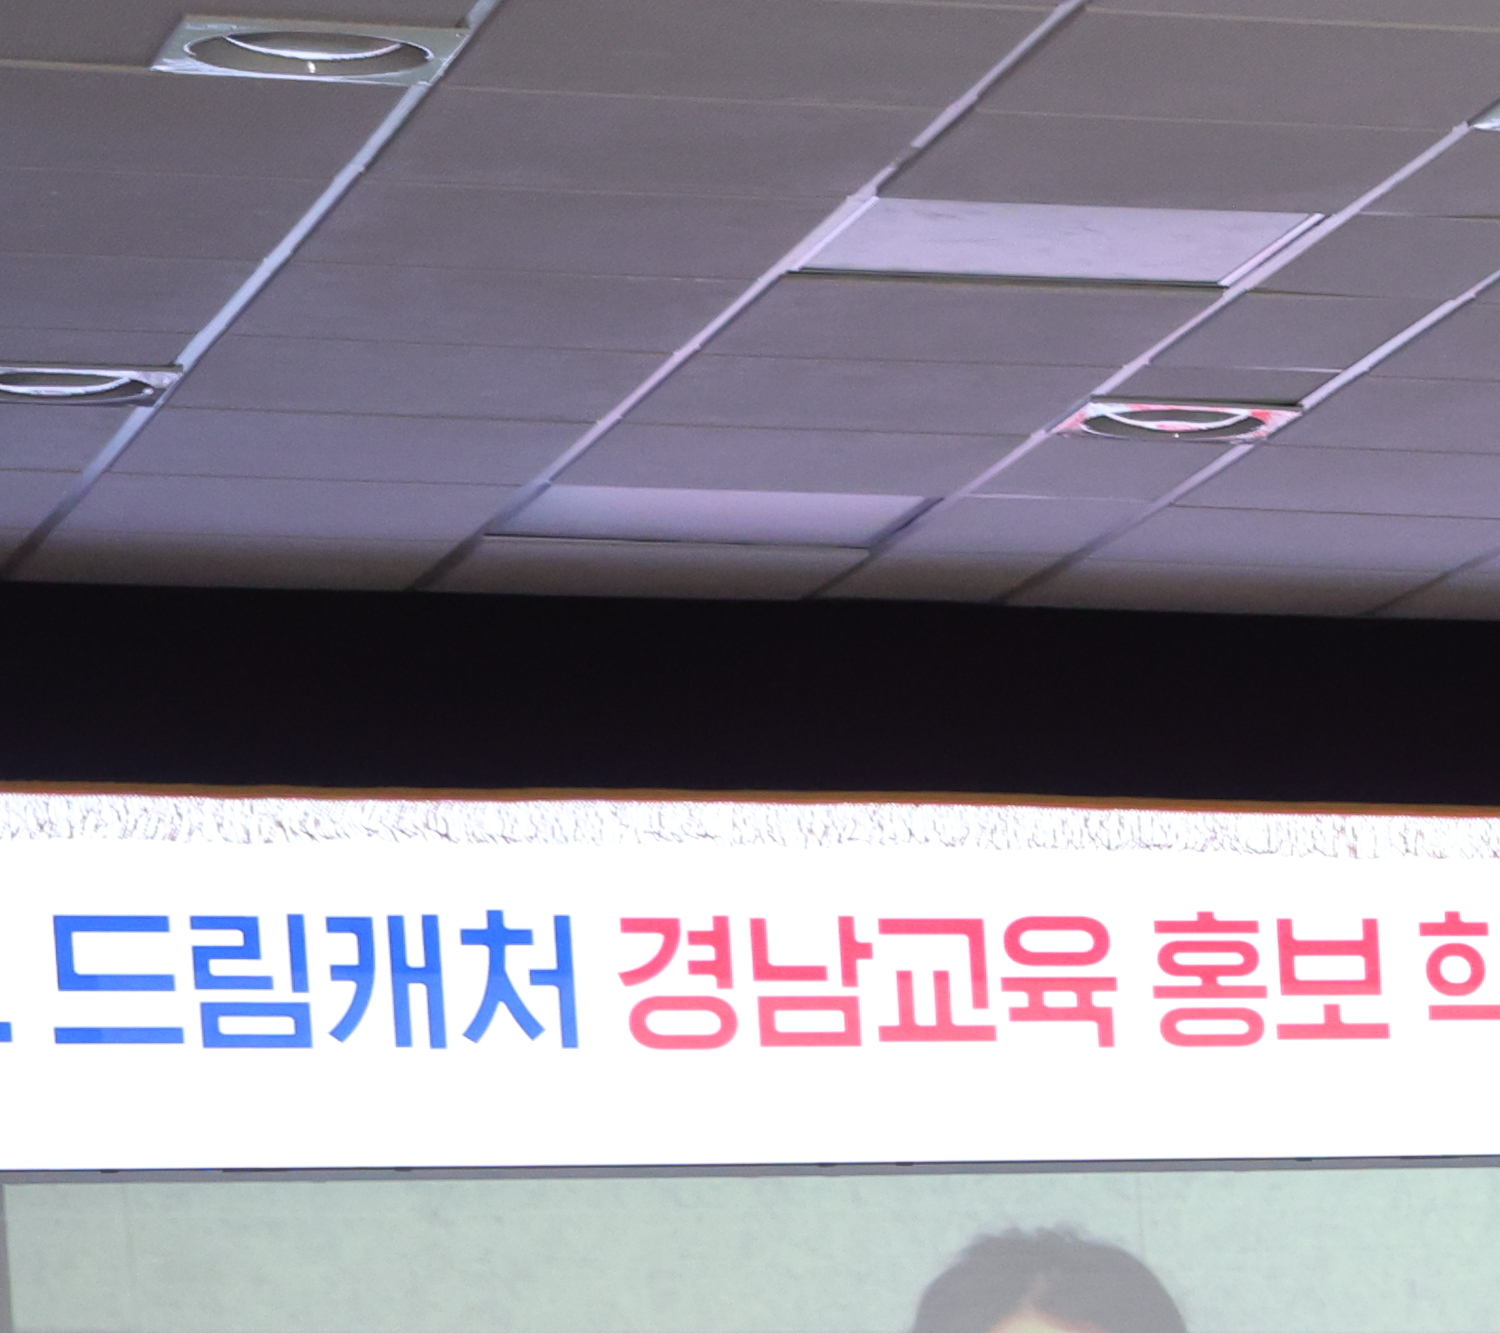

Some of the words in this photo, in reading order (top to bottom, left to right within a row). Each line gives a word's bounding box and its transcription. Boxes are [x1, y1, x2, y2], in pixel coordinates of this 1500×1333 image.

[52, 910, 579, 1050] 드림캐처
[619, 914, 1115, 1050] 경남교육
[1153, 912, 1390, 1042] 홍보
